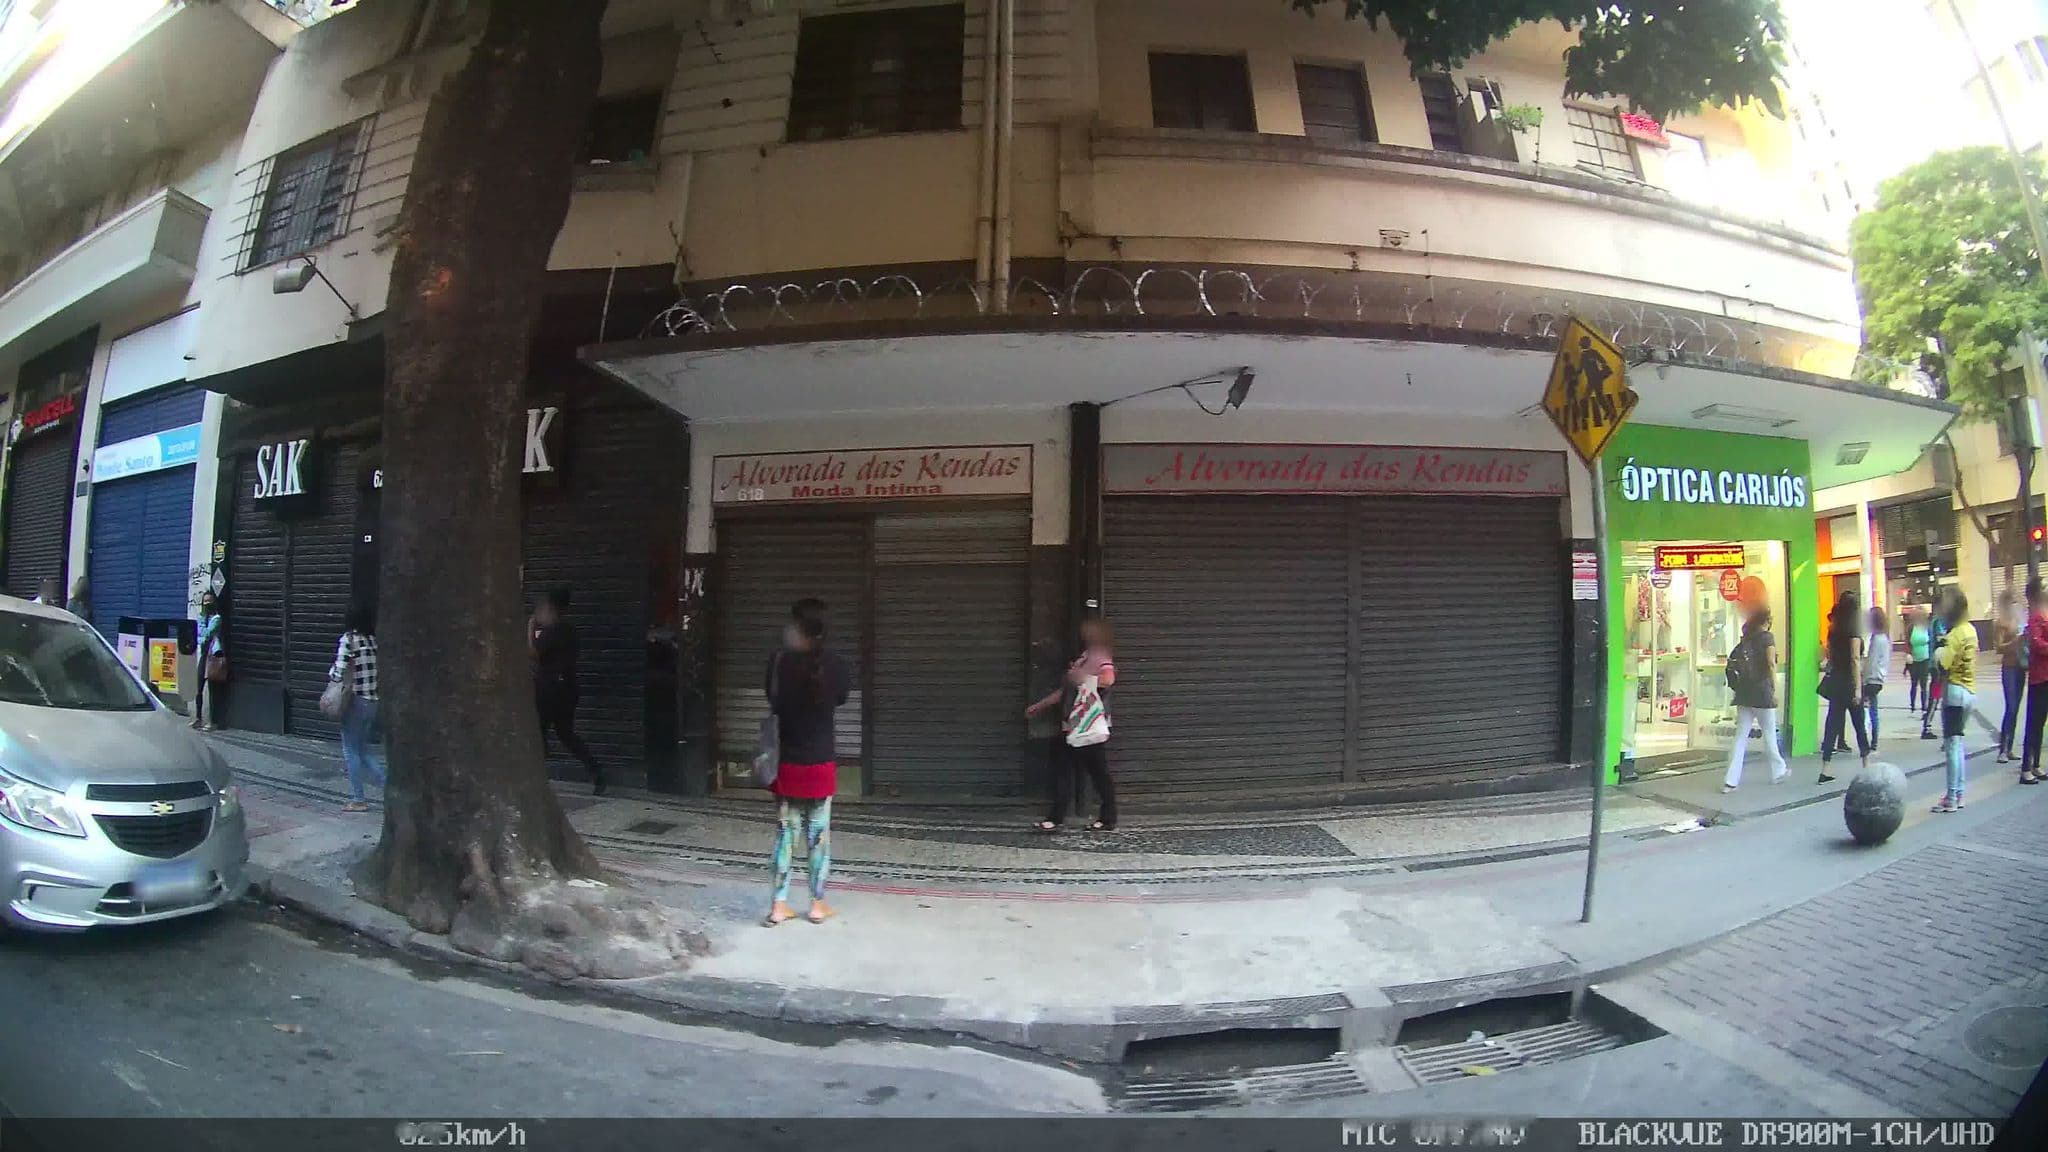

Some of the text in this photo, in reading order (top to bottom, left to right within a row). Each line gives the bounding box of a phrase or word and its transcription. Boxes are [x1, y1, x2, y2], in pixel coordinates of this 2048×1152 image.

[253, 438, 308, 499] SAK
[722, 450, 1020, 490] Alvorada das Rendas
[1147, 450, 1531, 485] Alvorada das Rendas
[1622, 457, 1805, 507] ÓPTICA CARIJÓS
[738, 487, 764, 500] 618
[792, 485, 942, 499] Moda Intima
